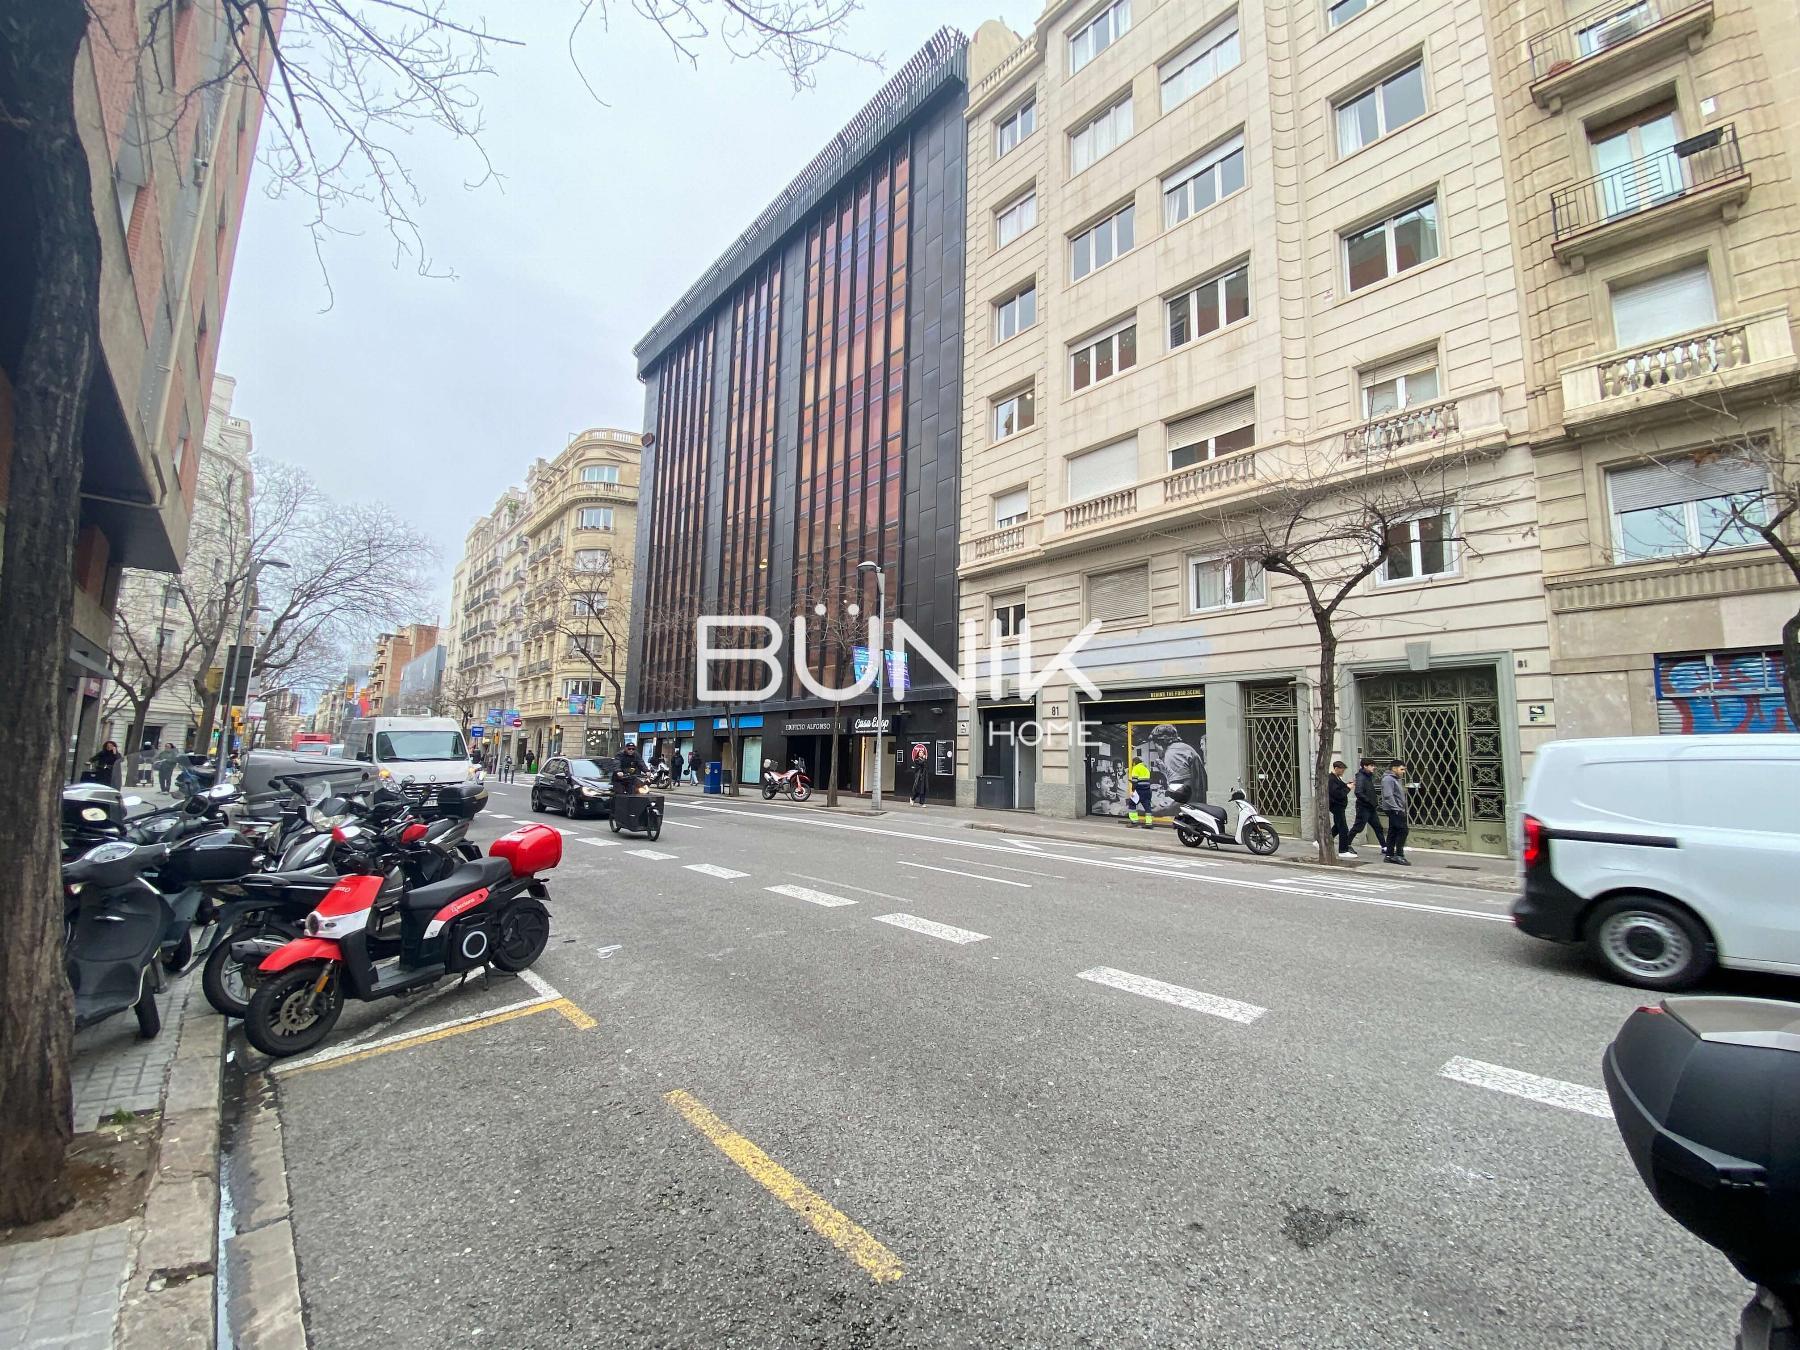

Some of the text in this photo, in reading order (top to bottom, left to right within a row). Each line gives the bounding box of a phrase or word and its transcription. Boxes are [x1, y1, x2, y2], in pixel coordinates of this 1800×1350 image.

[1051, 706, 1059, 716] 81
[785, 723, 806, 731] EDIFICIO
[806, 722, 831, 731] ALFONSO
[854, 718, 871, 729] Casa
